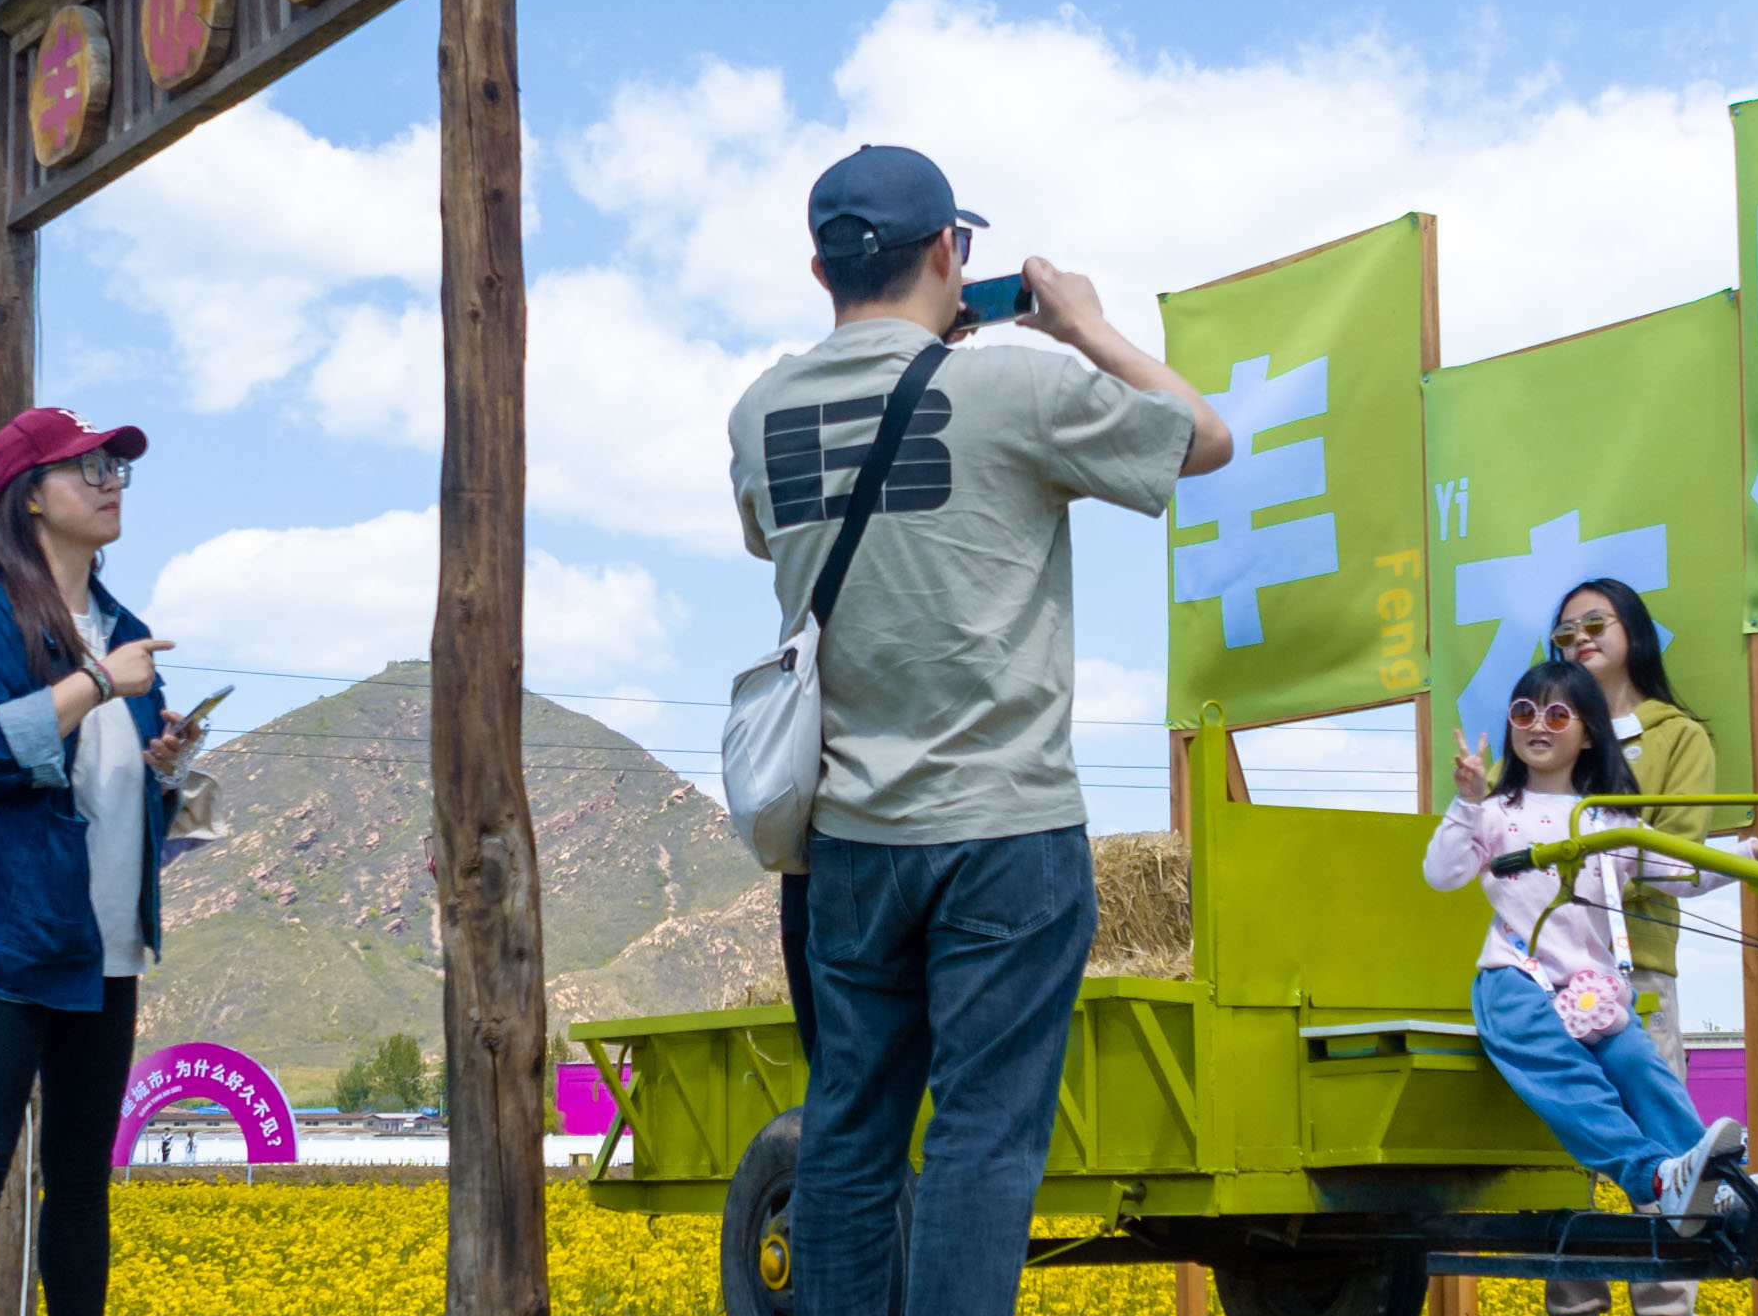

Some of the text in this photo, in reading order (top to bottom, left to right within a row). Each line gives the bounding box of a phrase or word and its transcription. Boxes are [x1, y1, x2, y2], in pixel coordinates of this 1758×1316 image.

[1173, 353, 1339, 649] 丰
[1434, 476, 1469, 541] Yi
[1374, 548, 1421, 691] Feng
